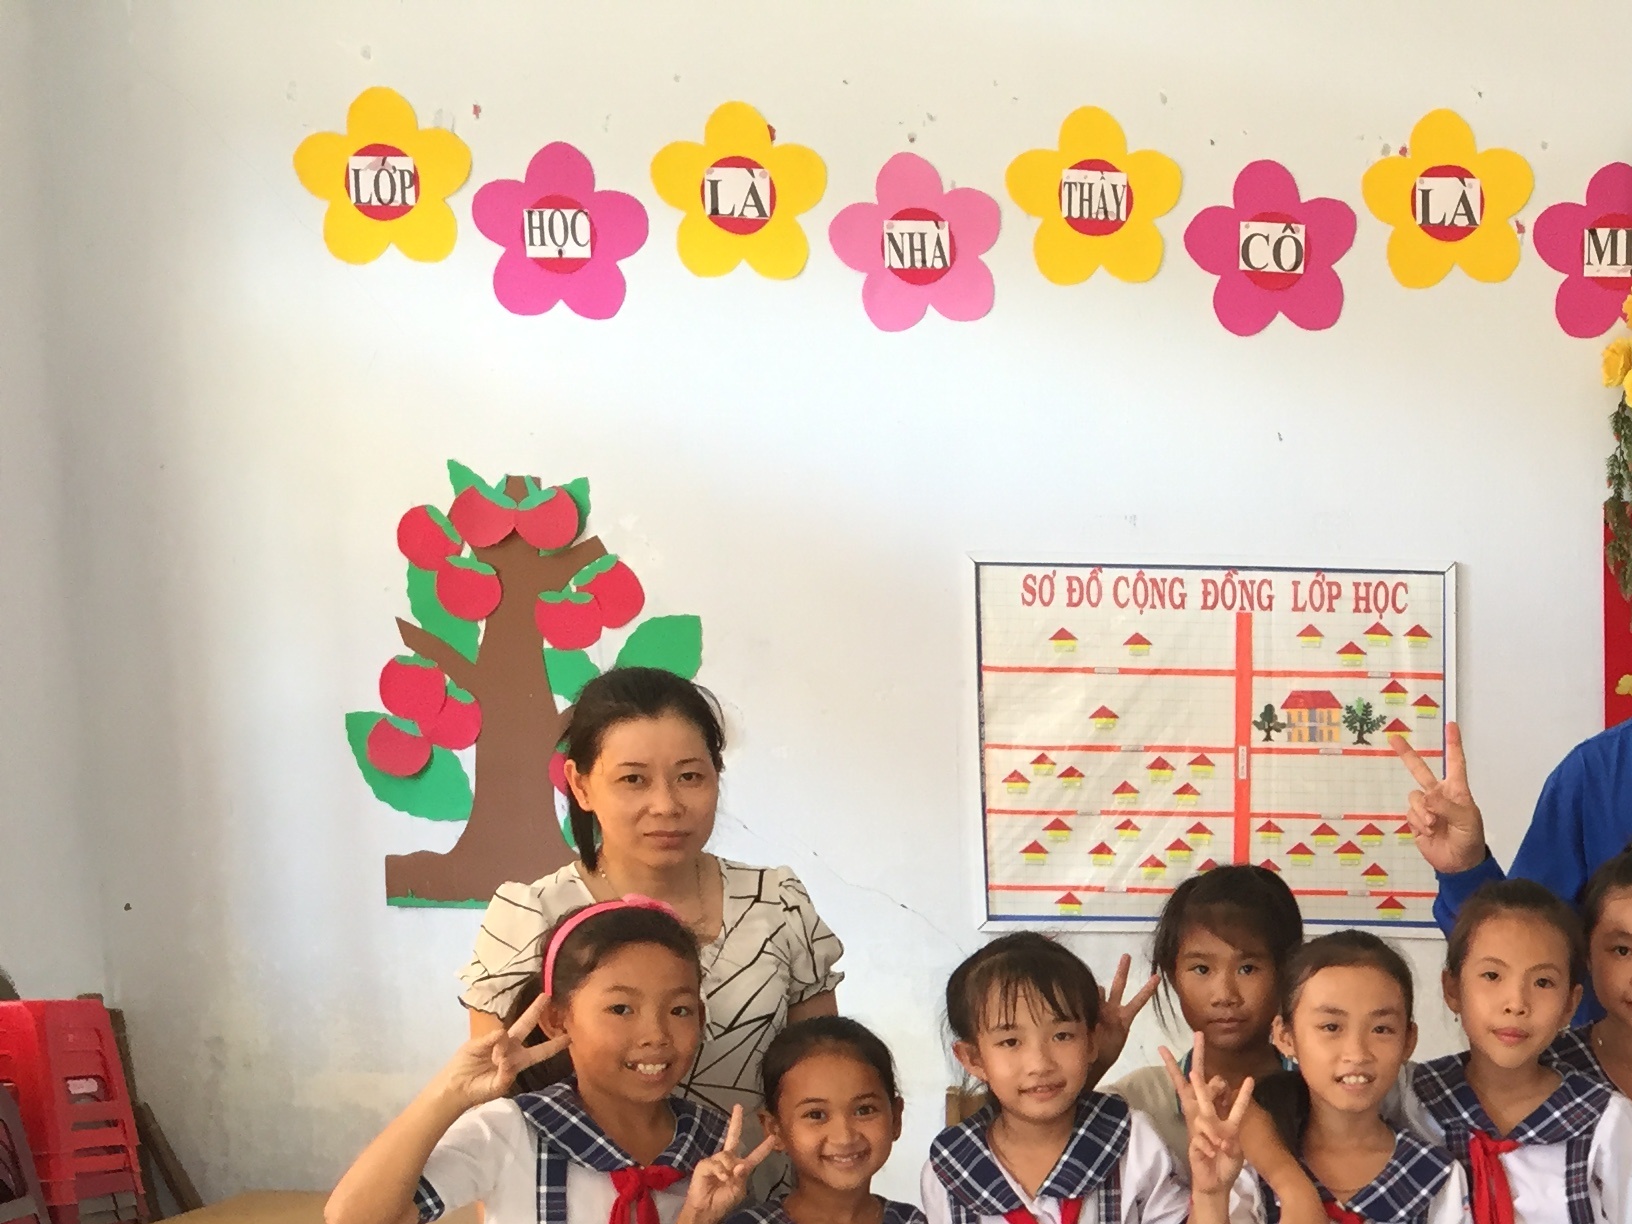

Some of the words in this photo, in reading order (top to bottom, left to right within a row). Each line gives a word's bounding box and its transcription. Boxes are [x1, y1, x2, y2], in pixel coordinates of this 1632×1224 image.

[352, 157, 414, 206] LỚP
[526, 209, 589, 258] HỌC
[706, 168, 768, 218] LÀ
[886, 221, 949, 269] NHÀ
[1241, 223, 1304, 272] CÔ
[1418, 177, 1480, 226] LÀ
[1021, 569, 1057, 608] SƠ
[1066, 565, 1103, 608] ĐỒ
[1112, 569, 1187, 616] CỘNG
[1201, 567, 1275, 611] ĐỒNG
[1291, 570, 1342, 614] LỚP
[1352, 580, 1409, 620] HỌC
